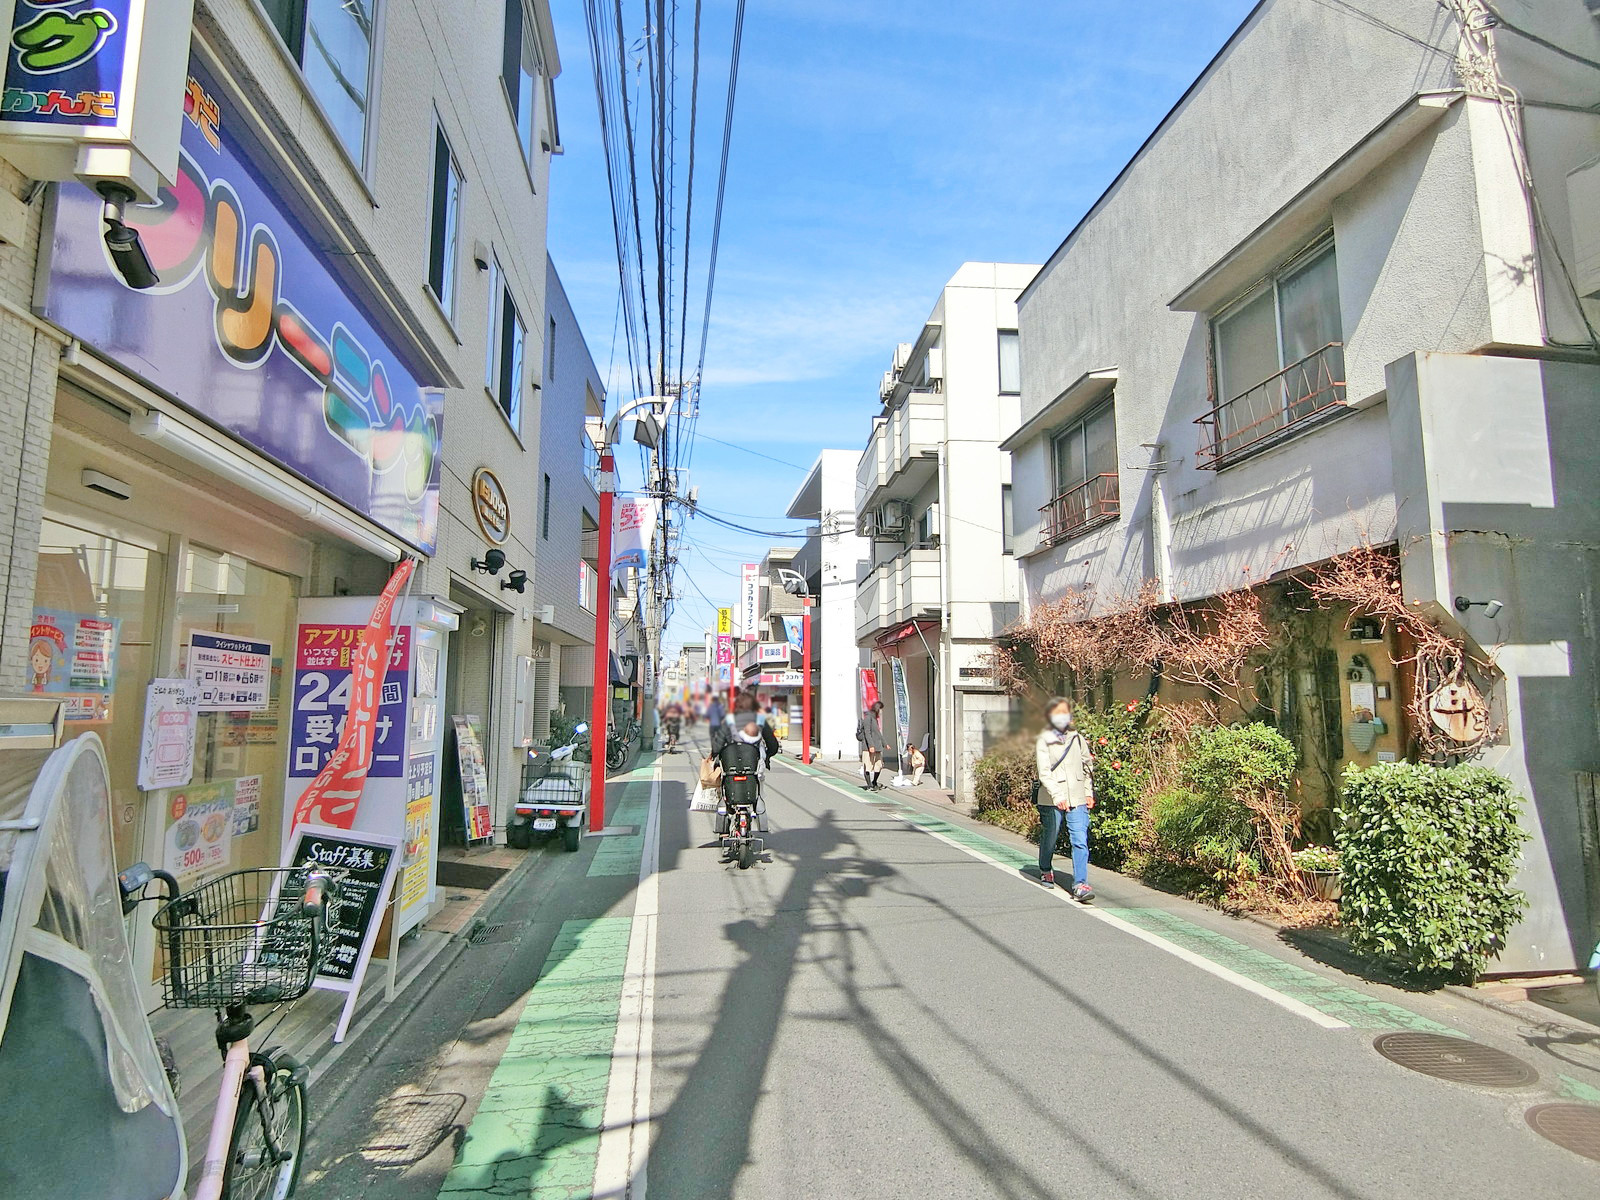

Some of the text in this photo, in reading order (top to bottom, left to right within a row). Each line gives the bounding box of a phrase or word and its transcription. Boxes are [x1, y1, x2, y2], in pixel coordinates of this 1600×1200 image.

[0, 88, 117, 118] かんだ
[303, 647, 339, 656] いつでも
[764, 648, 781, 657] 医薬品
[306, 656, 335, 666] 並ばず
[298, 671, 402, 711] 24間
